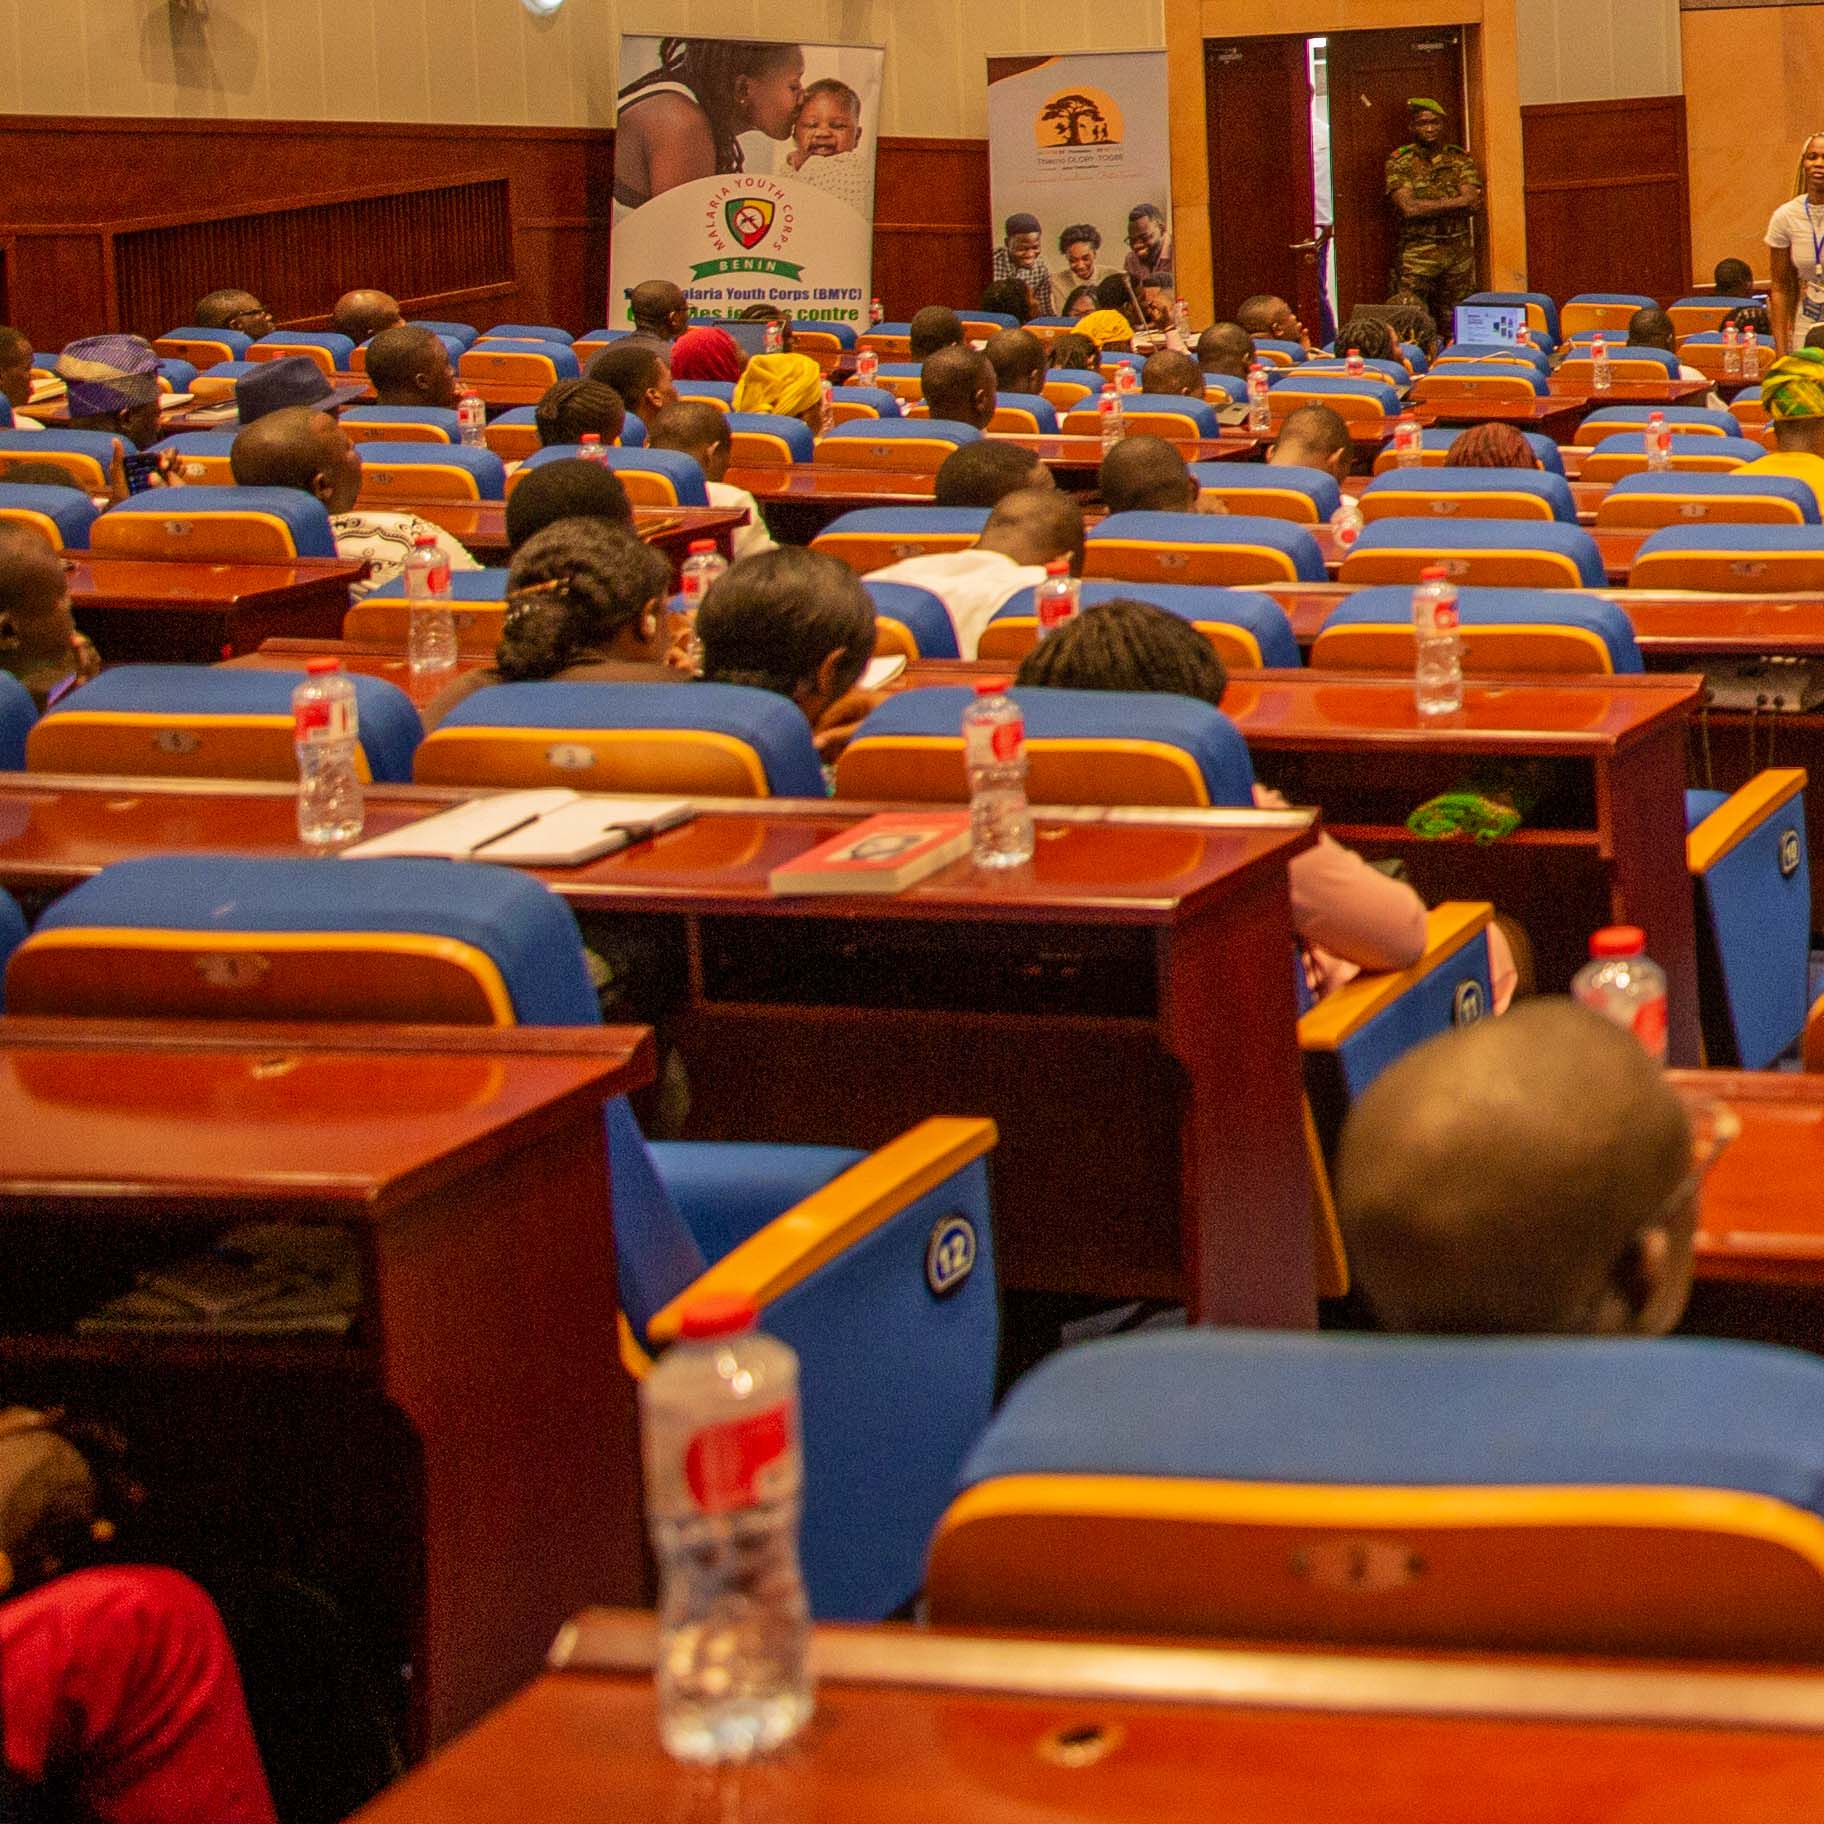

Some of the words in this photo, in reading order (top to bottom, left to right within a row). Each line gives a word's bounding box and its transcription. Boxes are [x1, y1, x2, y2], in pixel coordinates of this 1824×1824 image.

[706, 186, 731, 252] MALARIA
[734, 177, 785, 201] YOUTH
[773, 203, 794, 252] CORPS
[719, 259, 777, 272] BENIN
[682, 288, 723, 301] alaria
[726, 287, 766, 301] Youth
[769, 287, 810, 302] Corps
[797, 307, 860, 321] contre
[938, 1232, 969, 1276] 12
